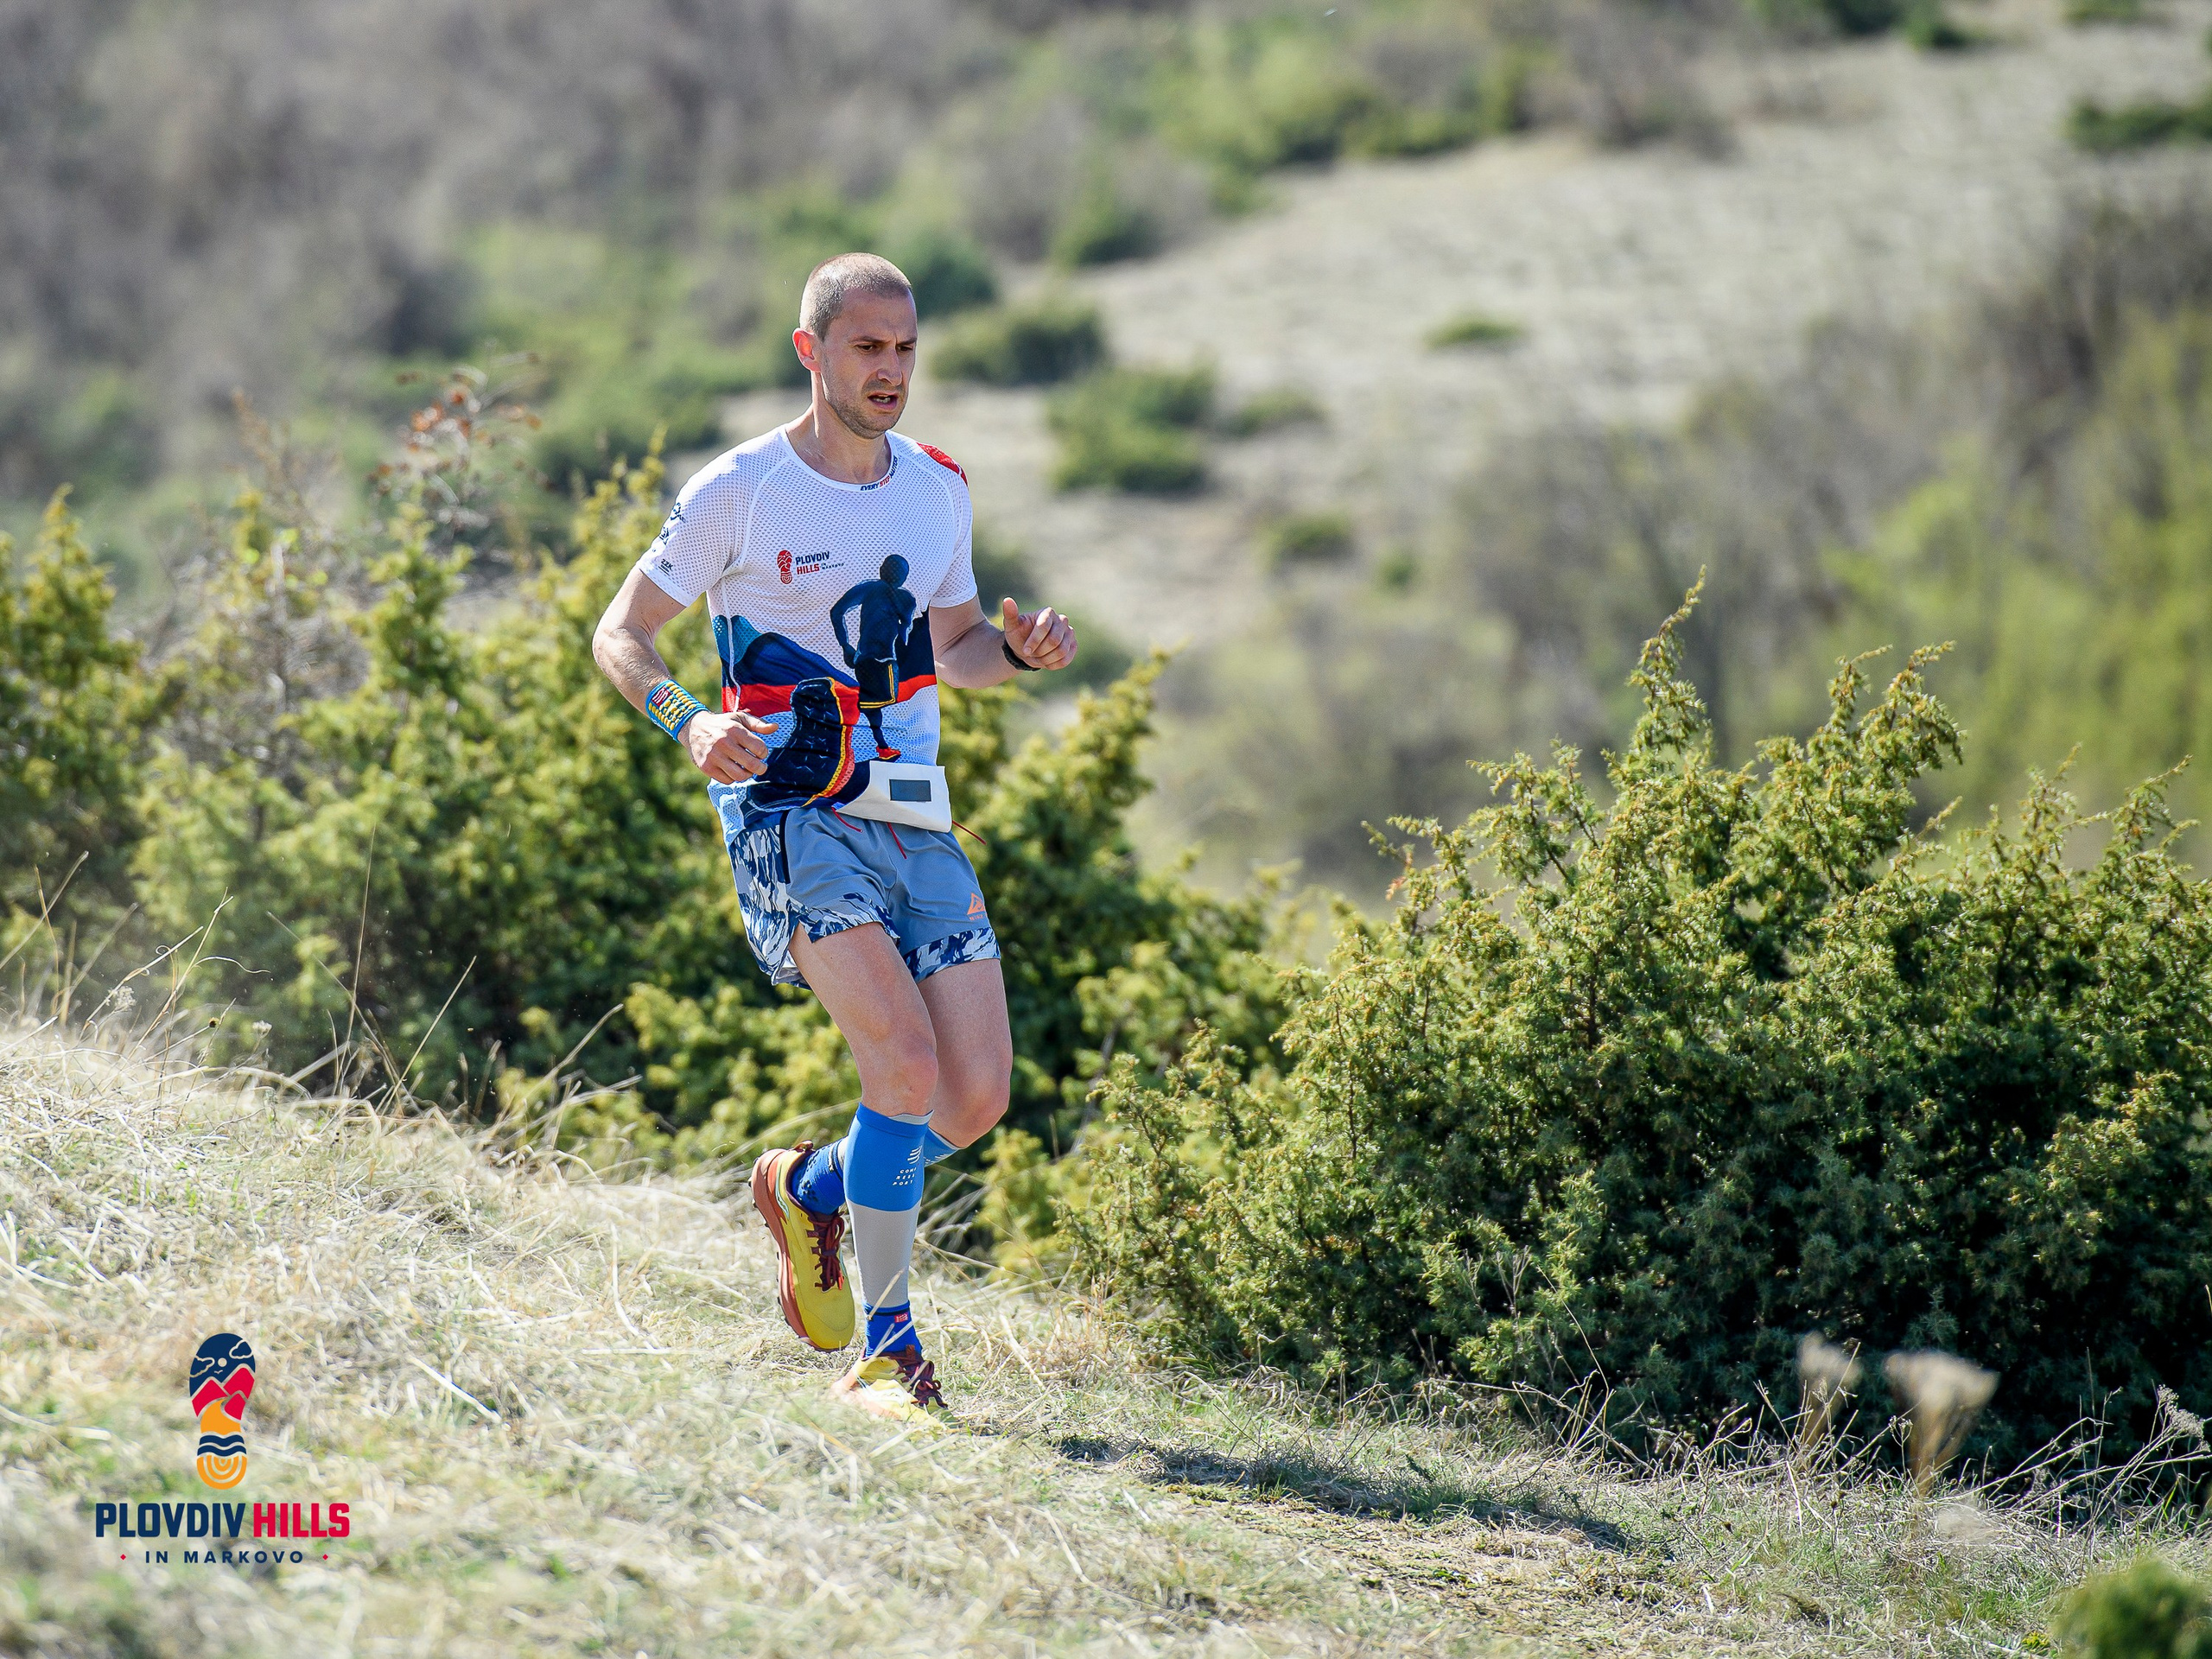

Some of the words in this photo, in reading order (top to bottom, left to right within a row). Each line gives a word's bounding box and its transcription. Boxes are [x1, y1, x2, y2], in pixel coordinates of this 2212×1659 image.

[860, 482, 880, 491] EVERY
[880, 475, 890, 487] STEP
[795, 551, 830, 565] PLOVDIV
[797, 563, 820, 575] HILLS
